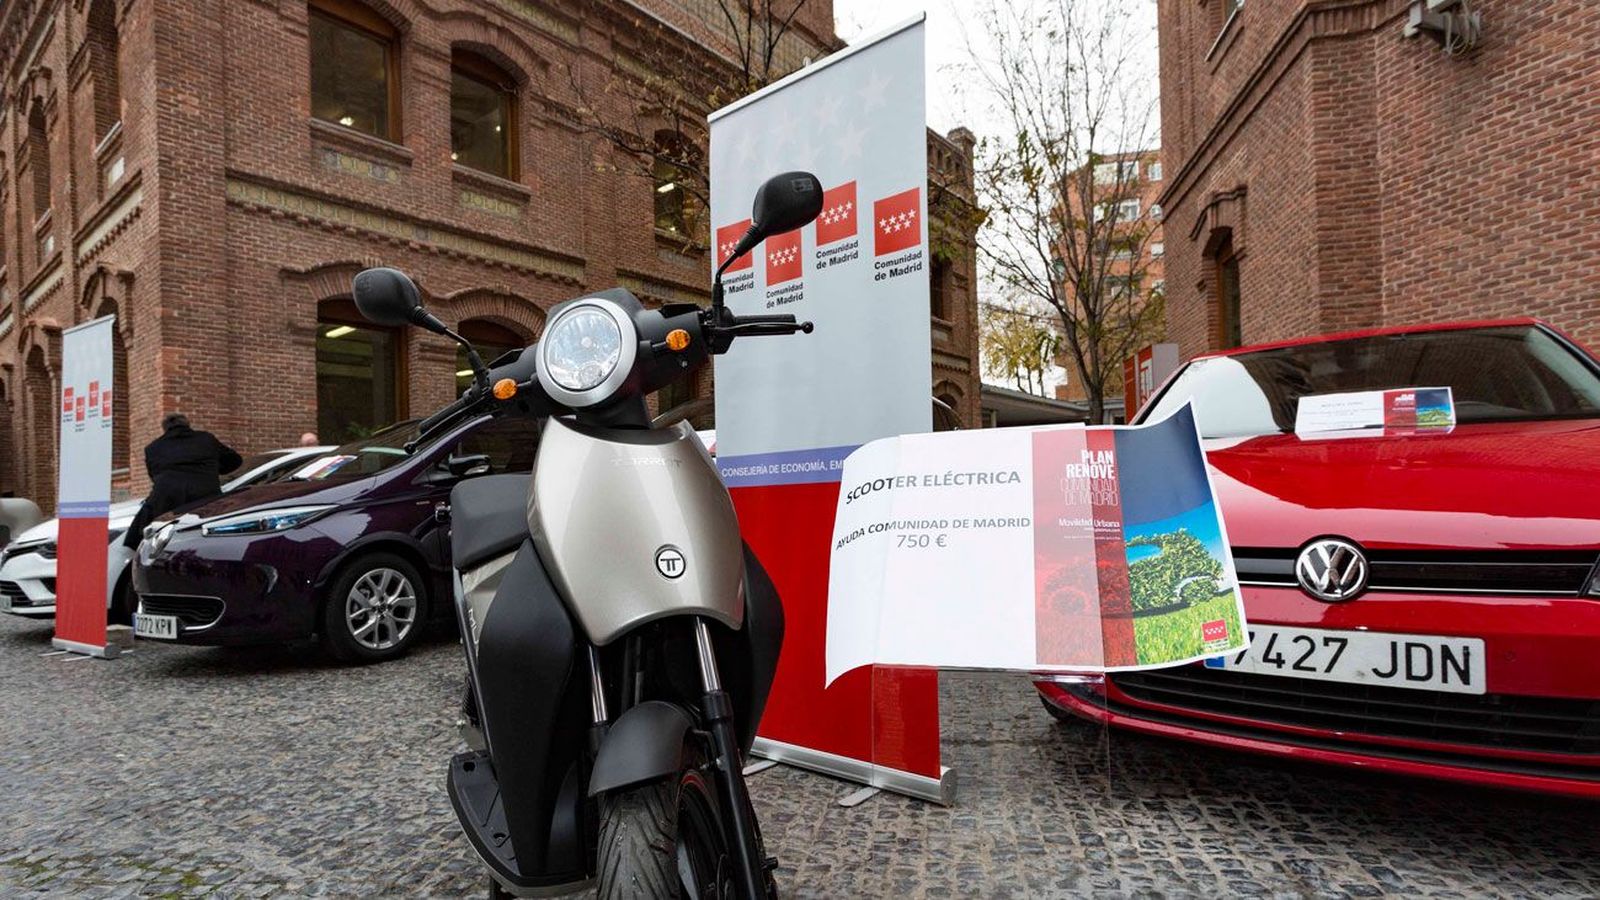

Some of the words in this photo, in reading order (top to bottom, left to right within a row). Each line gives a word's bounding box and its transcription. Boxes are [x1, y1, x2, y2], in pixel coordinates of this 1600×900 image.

[816, 240, 859, 259] Comunidad
[816, 261, 827, 270] de
[829, 250, 859, 266] Madrid
[874, 250, 922, 270] Comunidad
[722, 272, 754, 285] omunidad
[874, 272, 887, 281] de
[889, 261, 922, 278] Madrid
[728, 281, 754, 294] Madrid
[766, 282, 803, 299] Comunidad
[766, 301, 775, 309] de
[776, 291, 803, 306] Madrid
[1081, 450, 1114, 464] PLAN
[768, 464, 780, 474] DE
[1066, 464, 1115, 479] RENOVE
[846, 475, 917, 504] SCOOTER
[923, 471, 1021, 488] ELÉCTRICA
[1058, 517, 1093, 527] Movilidad
[1093, 519, 1120, 528] Urbana
[836, 528, 865, 550] AYUDA
[868, 520, 949, 534] COMUNIDAD
[953, 519, 970, 529] DE
[973, 517, 1031, 529] MADRID
[897, 534, 930, 549] 750
[935, 533, 948, 548] €
[1371, 640, 1471, 686] JDN
